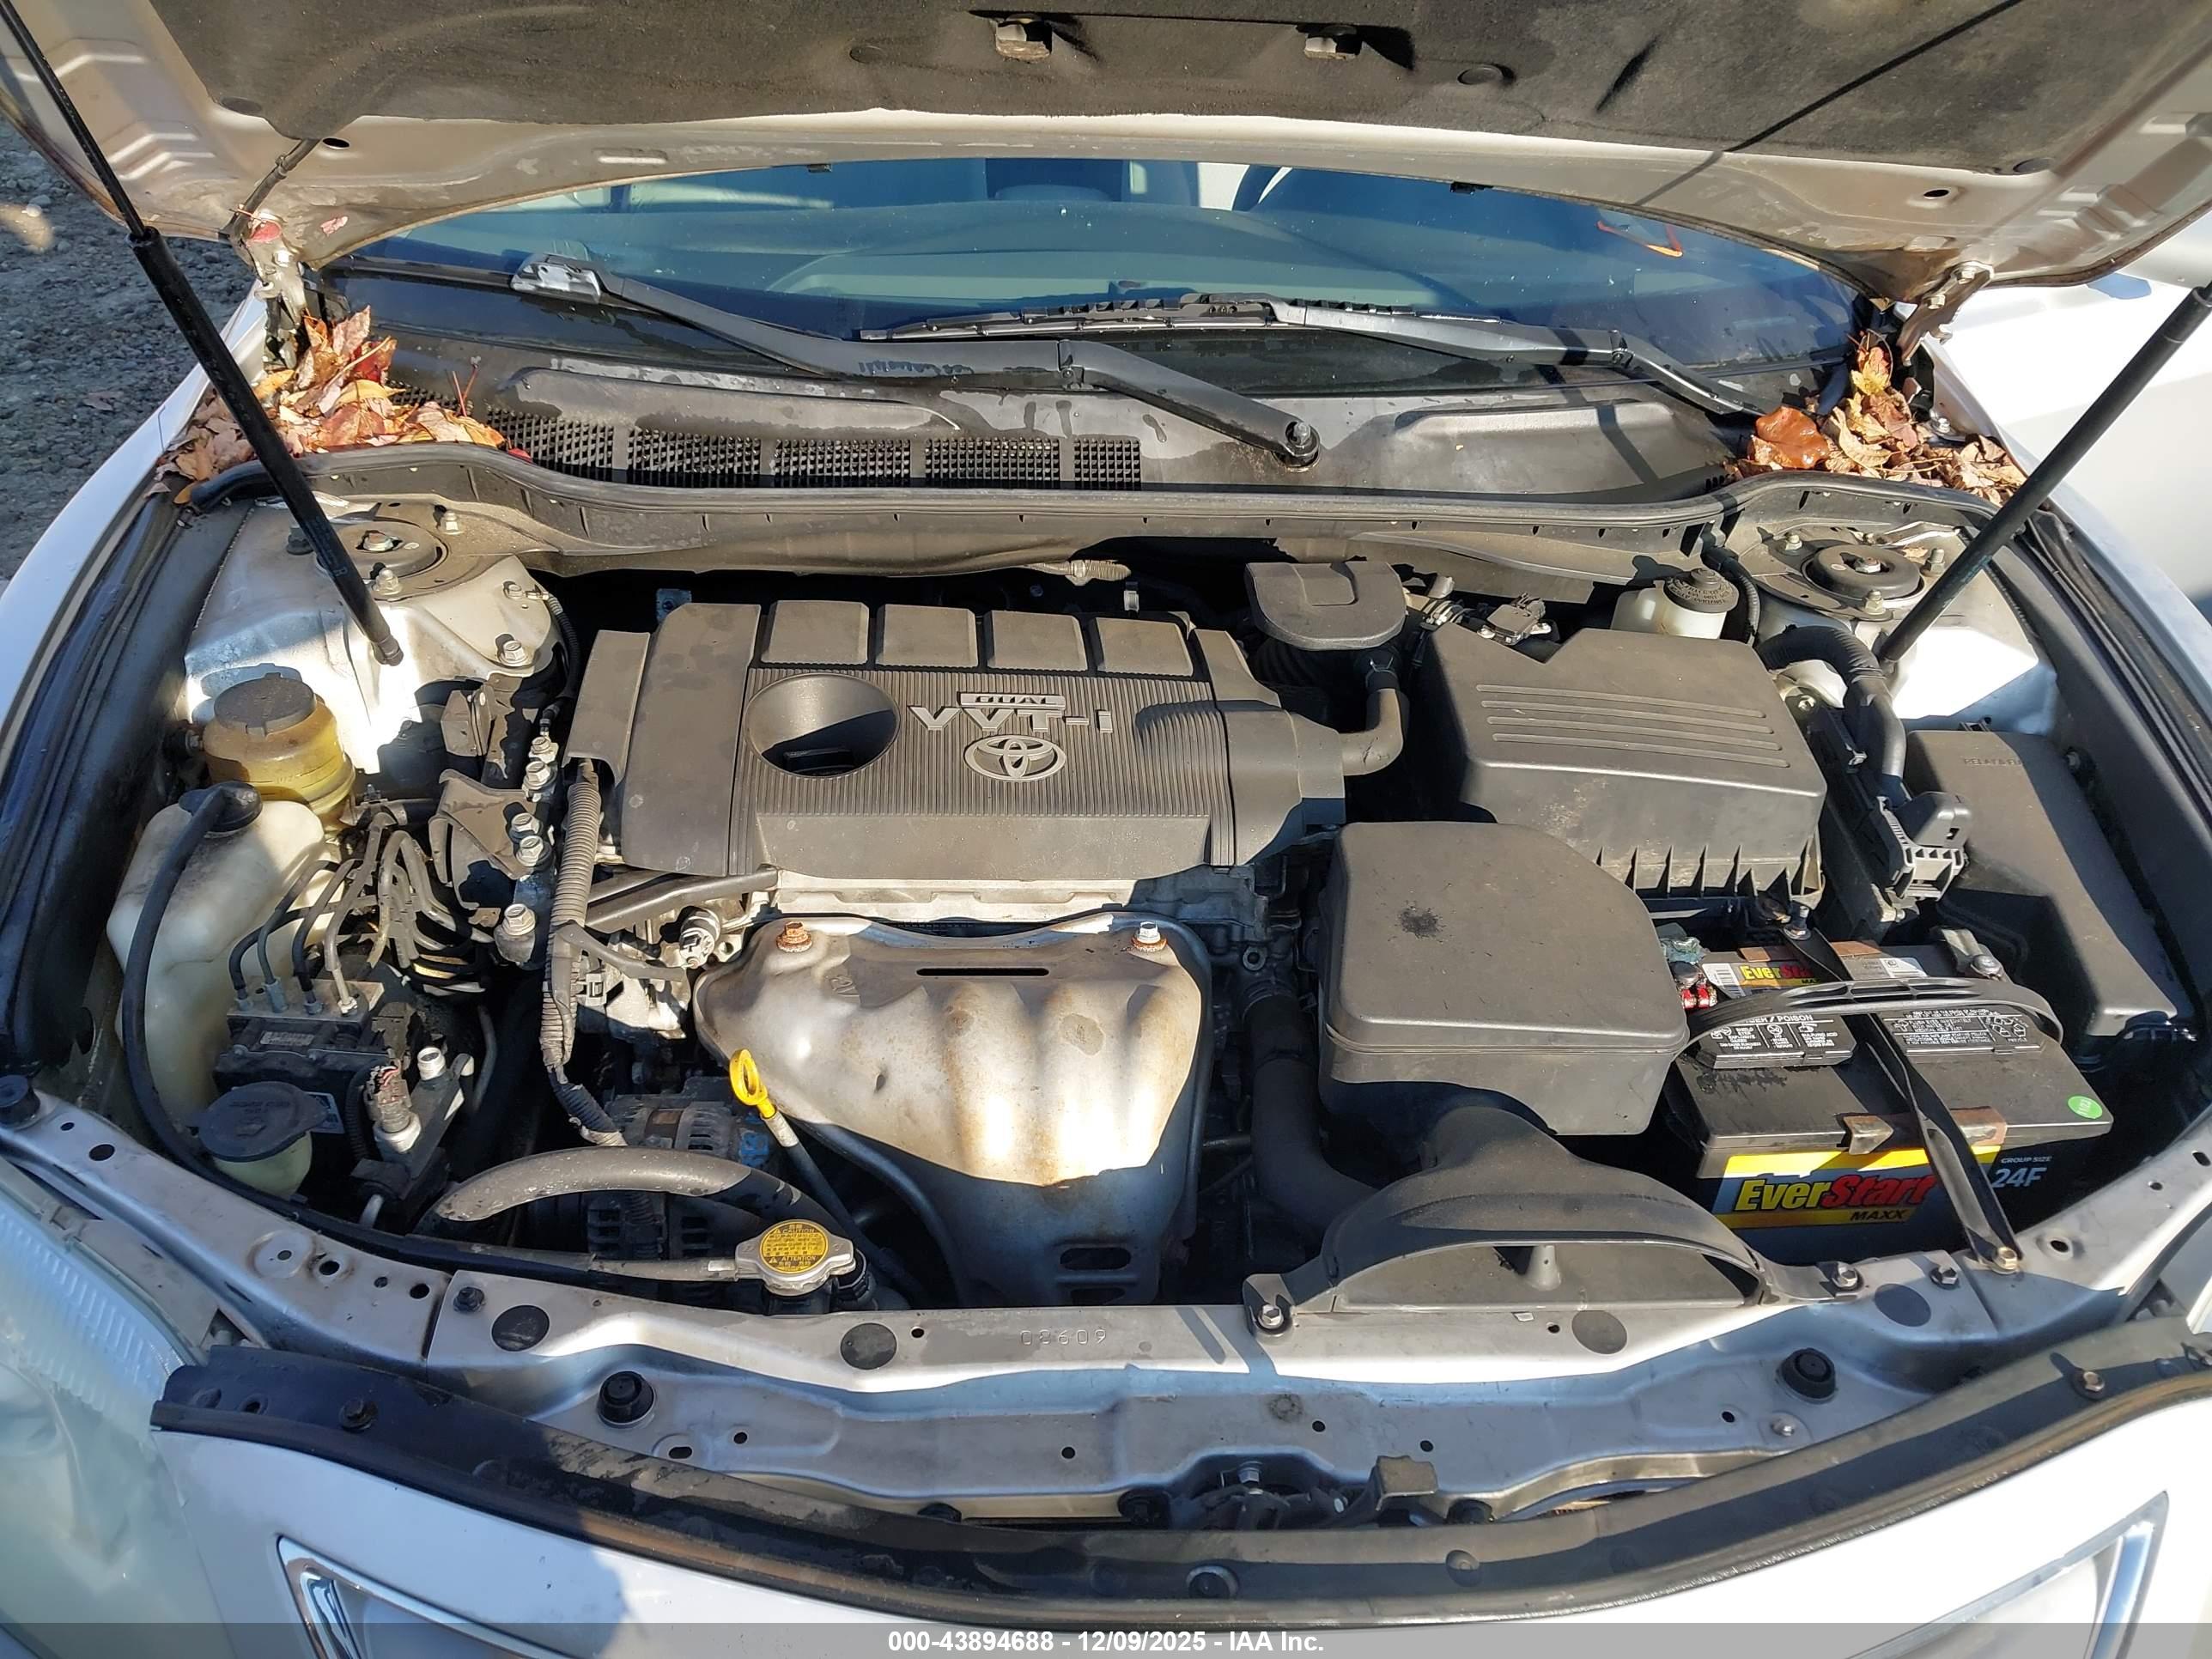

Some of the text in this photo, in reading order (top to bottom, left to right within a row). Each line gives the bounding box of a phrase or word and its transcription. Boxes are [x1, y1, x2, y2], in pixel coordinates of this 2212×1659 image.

[1992, 1167, 2048, 1188] 24F
[1734, 1174, 1938, 1212] EverStart
[1850, 1209, 1907, 1221] MAXX
